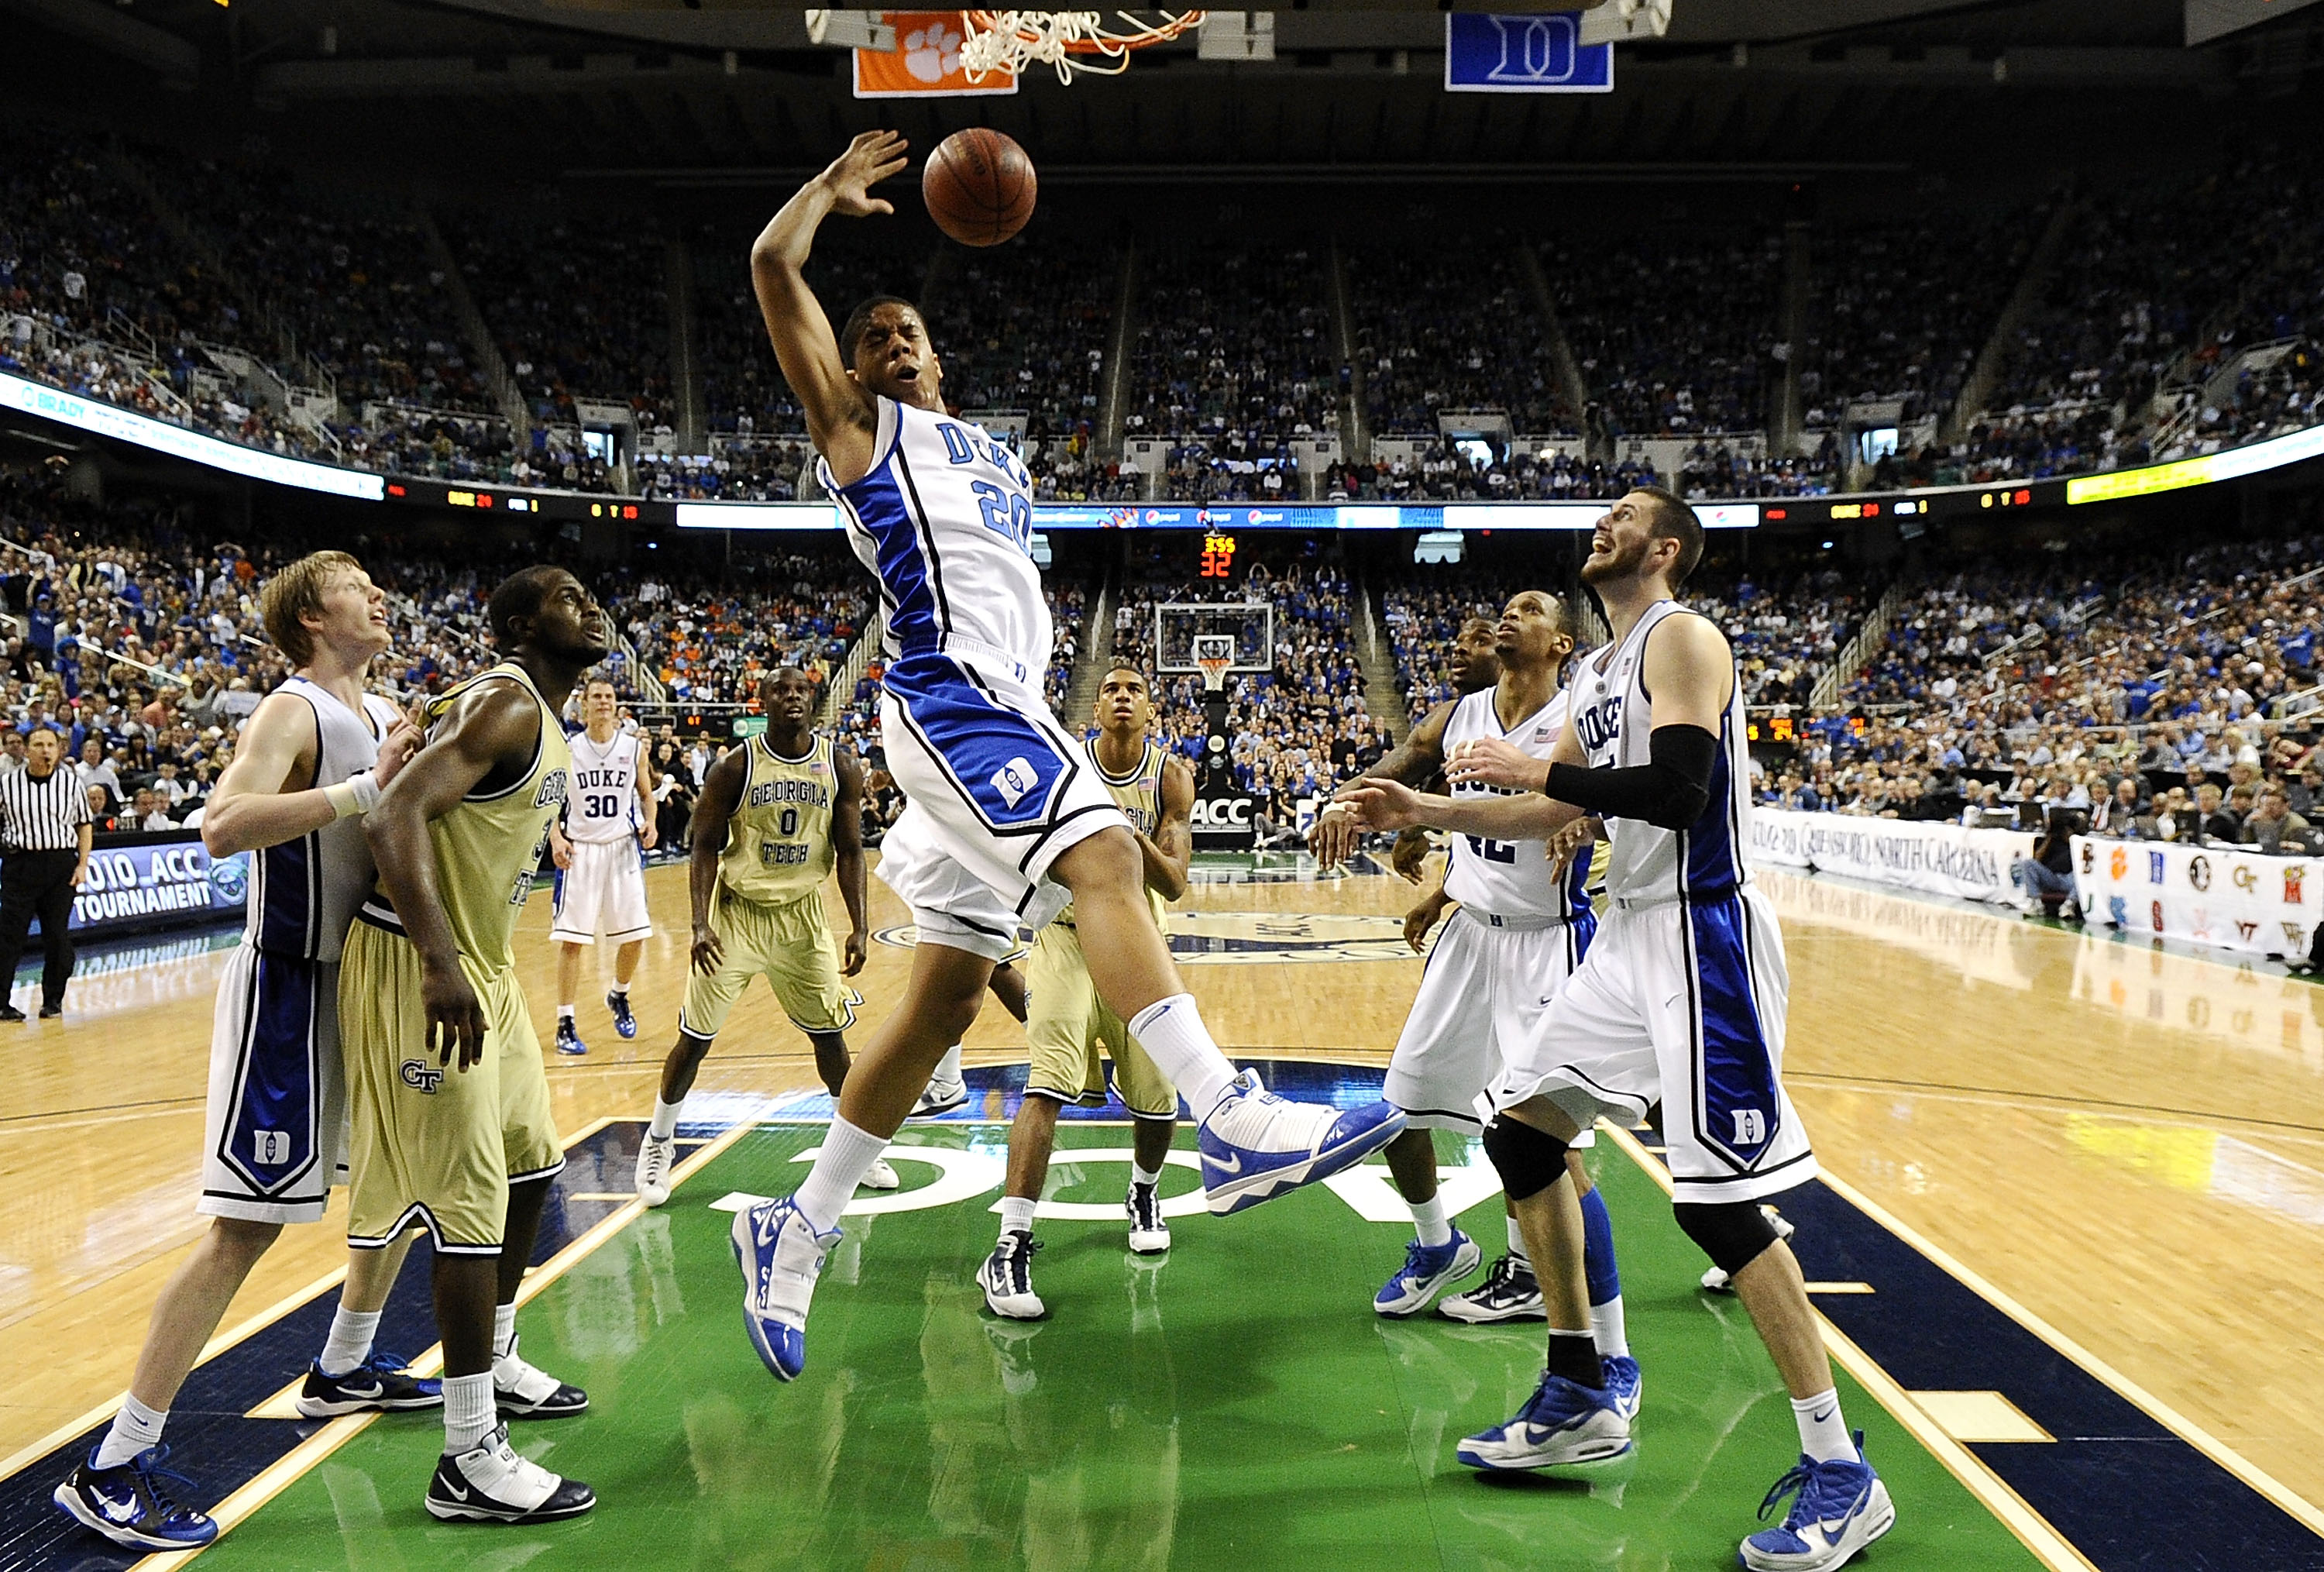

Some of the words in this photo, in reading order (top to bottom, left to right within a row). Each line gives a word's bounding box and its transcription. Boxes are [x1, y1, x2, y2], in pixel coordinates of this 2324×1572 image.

[39, 392, 85, 420] BRADY
[1205, 537, 1236, 553] 3:55
[1201, 551, 1231, 576] 32
[577, 770, 627, 789] DUKE
[585, 795, 617, 818] 30
[750, 780, 828, 808] GEORGIA
[779, 808, 798, 836] 0
[1189, 797, 1253, 825] ACC
[762, 841, 809, 864] TECH
[75, 851, 138, 893] 010
[152, 848, 203, 884] ACC
[74, 882, 211, 923] TOURNAMENT
[400, 1059, 445, 1094] GT
